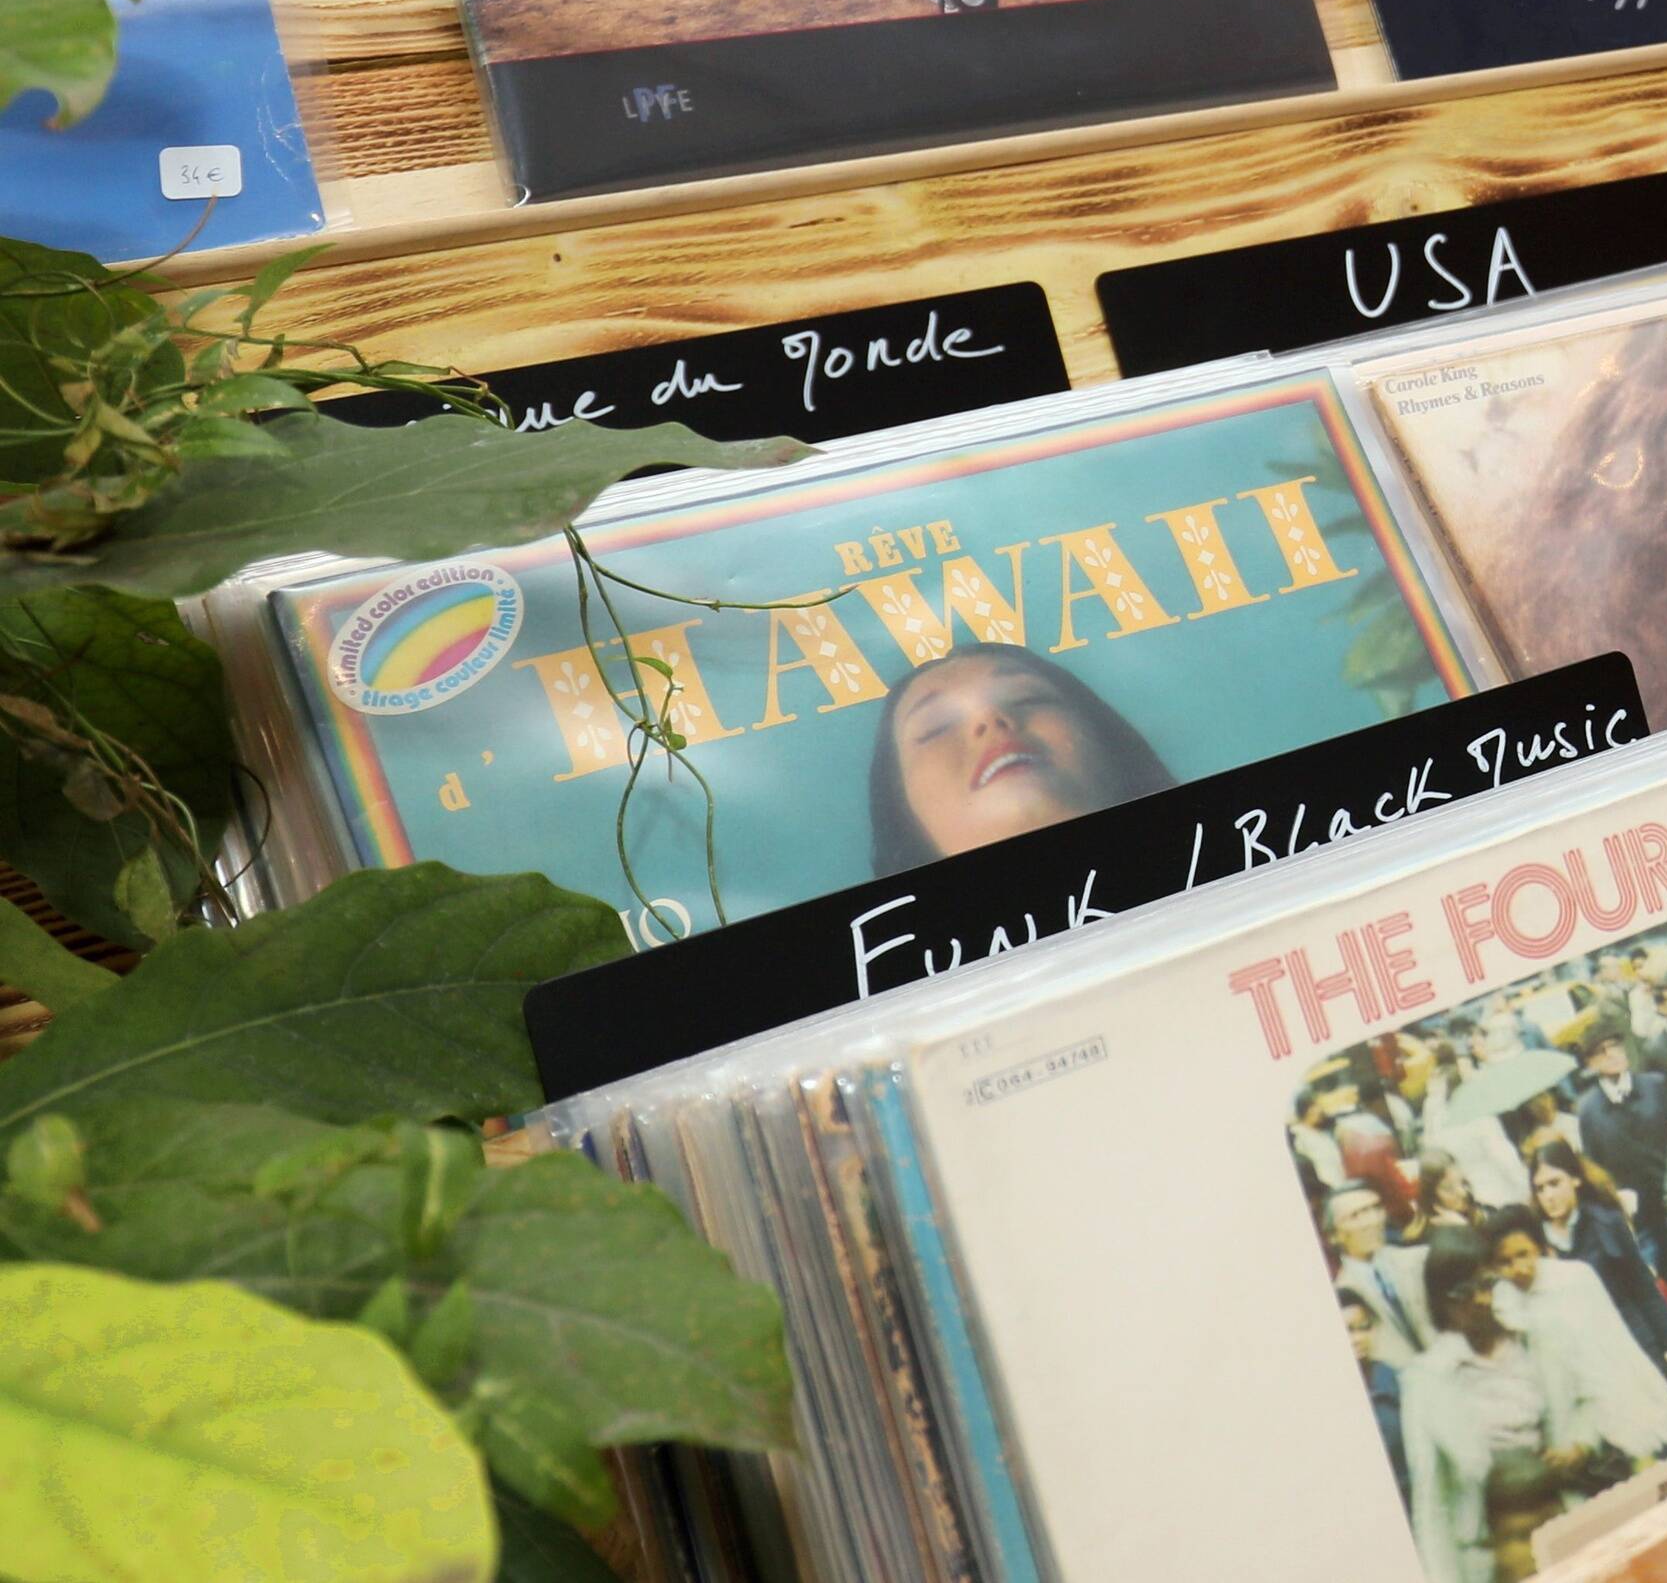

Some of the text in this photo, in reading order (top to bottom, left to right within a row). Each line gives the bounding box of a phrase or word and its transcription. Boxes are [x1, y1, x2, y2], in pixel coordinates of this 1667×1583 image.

[1345, 227, 1543, 319] USA
[651, 359, 743, 405] du
[1385, 364, 1479, 395] Carole King
[1397, 373, 1545, 417] Rhymes & Reasons
[833, 518, 961, 578] RÊVE
[335, 565, 495, 688] limited color edition
[361, 587, 517, 709] tirage couleur limité
[511, 475, 1360, 783] HAWAII
[1466, 704, 1638, 792] Music
[1228, 910, 1437, 1062] THE
